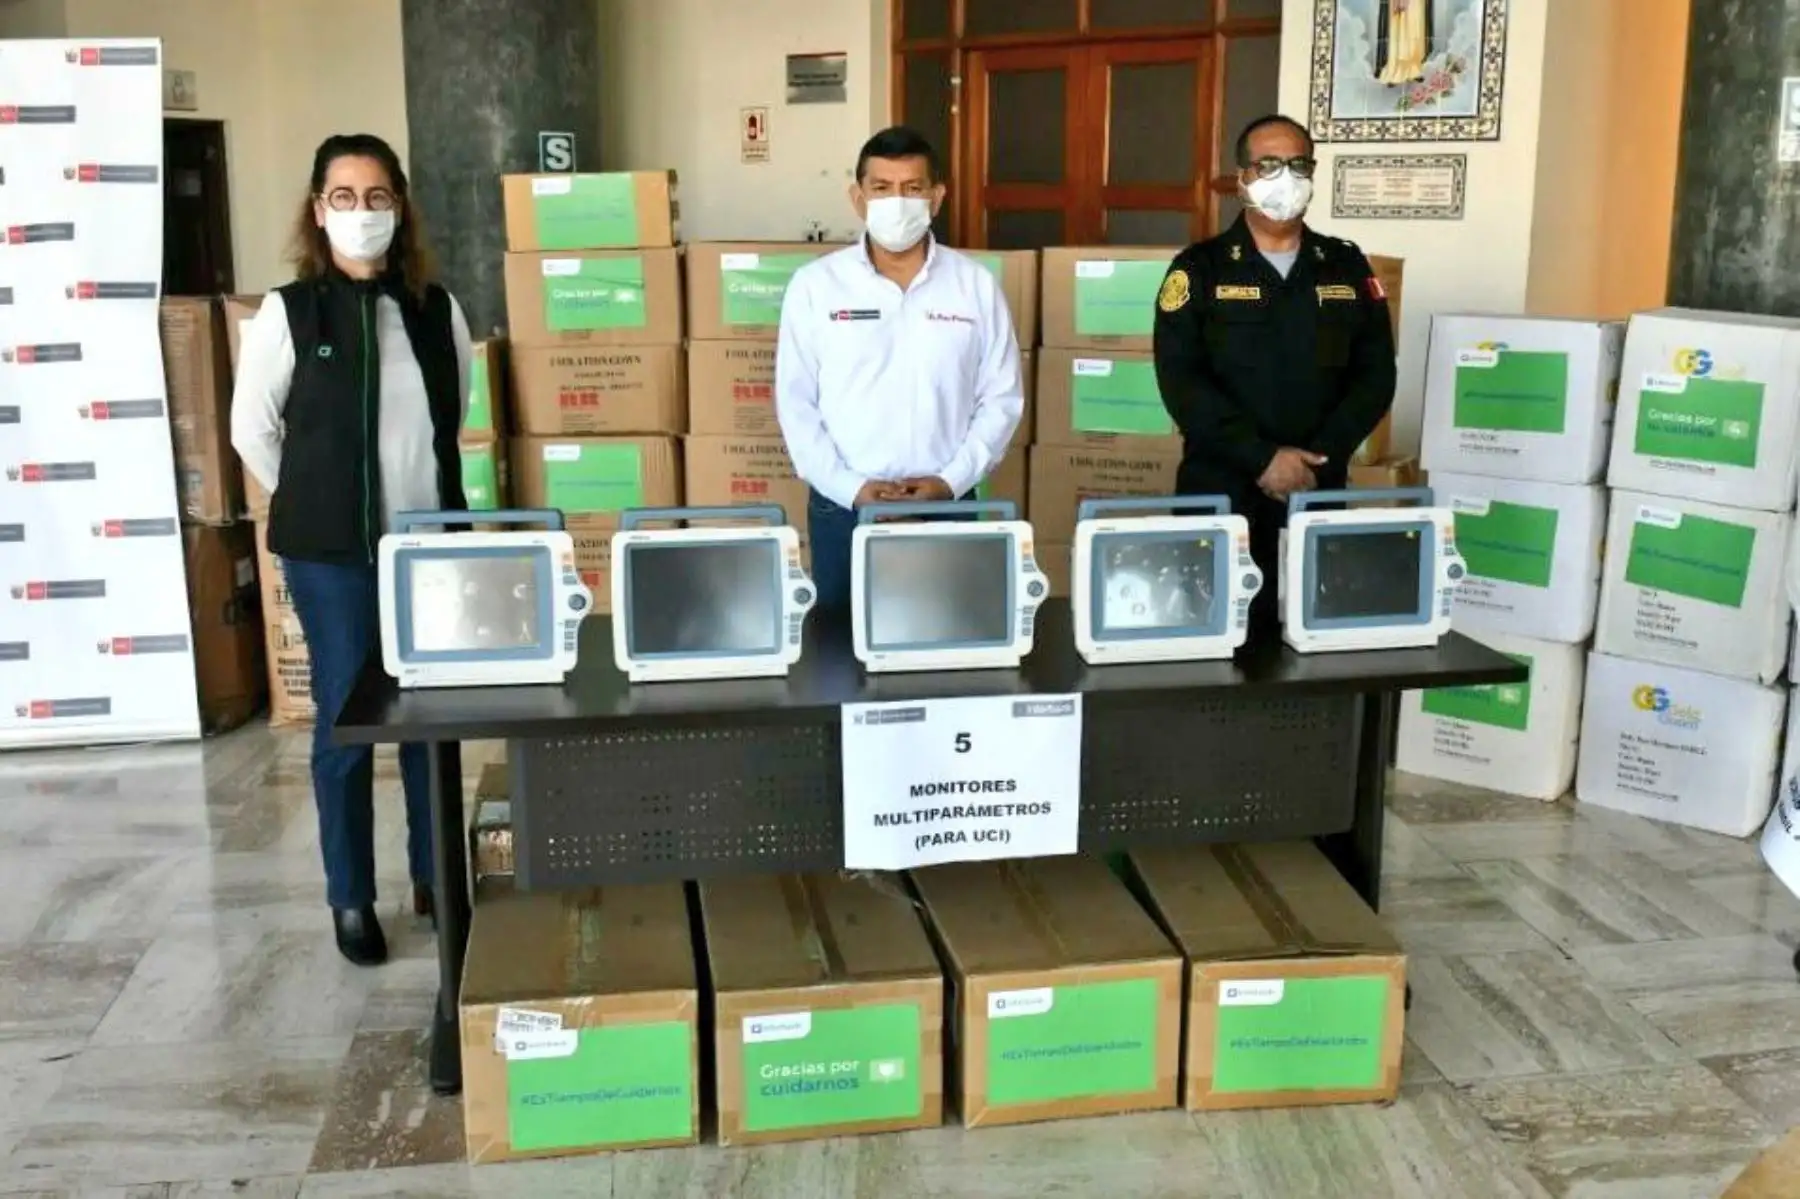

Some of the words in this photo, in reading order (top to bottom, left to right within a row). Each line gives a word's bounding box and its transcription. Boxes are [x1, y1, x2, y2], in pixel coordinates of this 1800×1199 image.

[546, 137, 572, 170] S
[954, 731, 972, 754] 5
[909, 778, 1018, 798] MONITORES
[873, 800, 1052, 827] MULTIPARÁMETROS
[914, 830, 967, 851] (PARA
[973, 828, 1012, 845] UCI)
[759, 1061, 826, 1079] Gracias
[830, 1059, 861, 1075] por
[759, 1077, 861, 1097] cuidarnos
